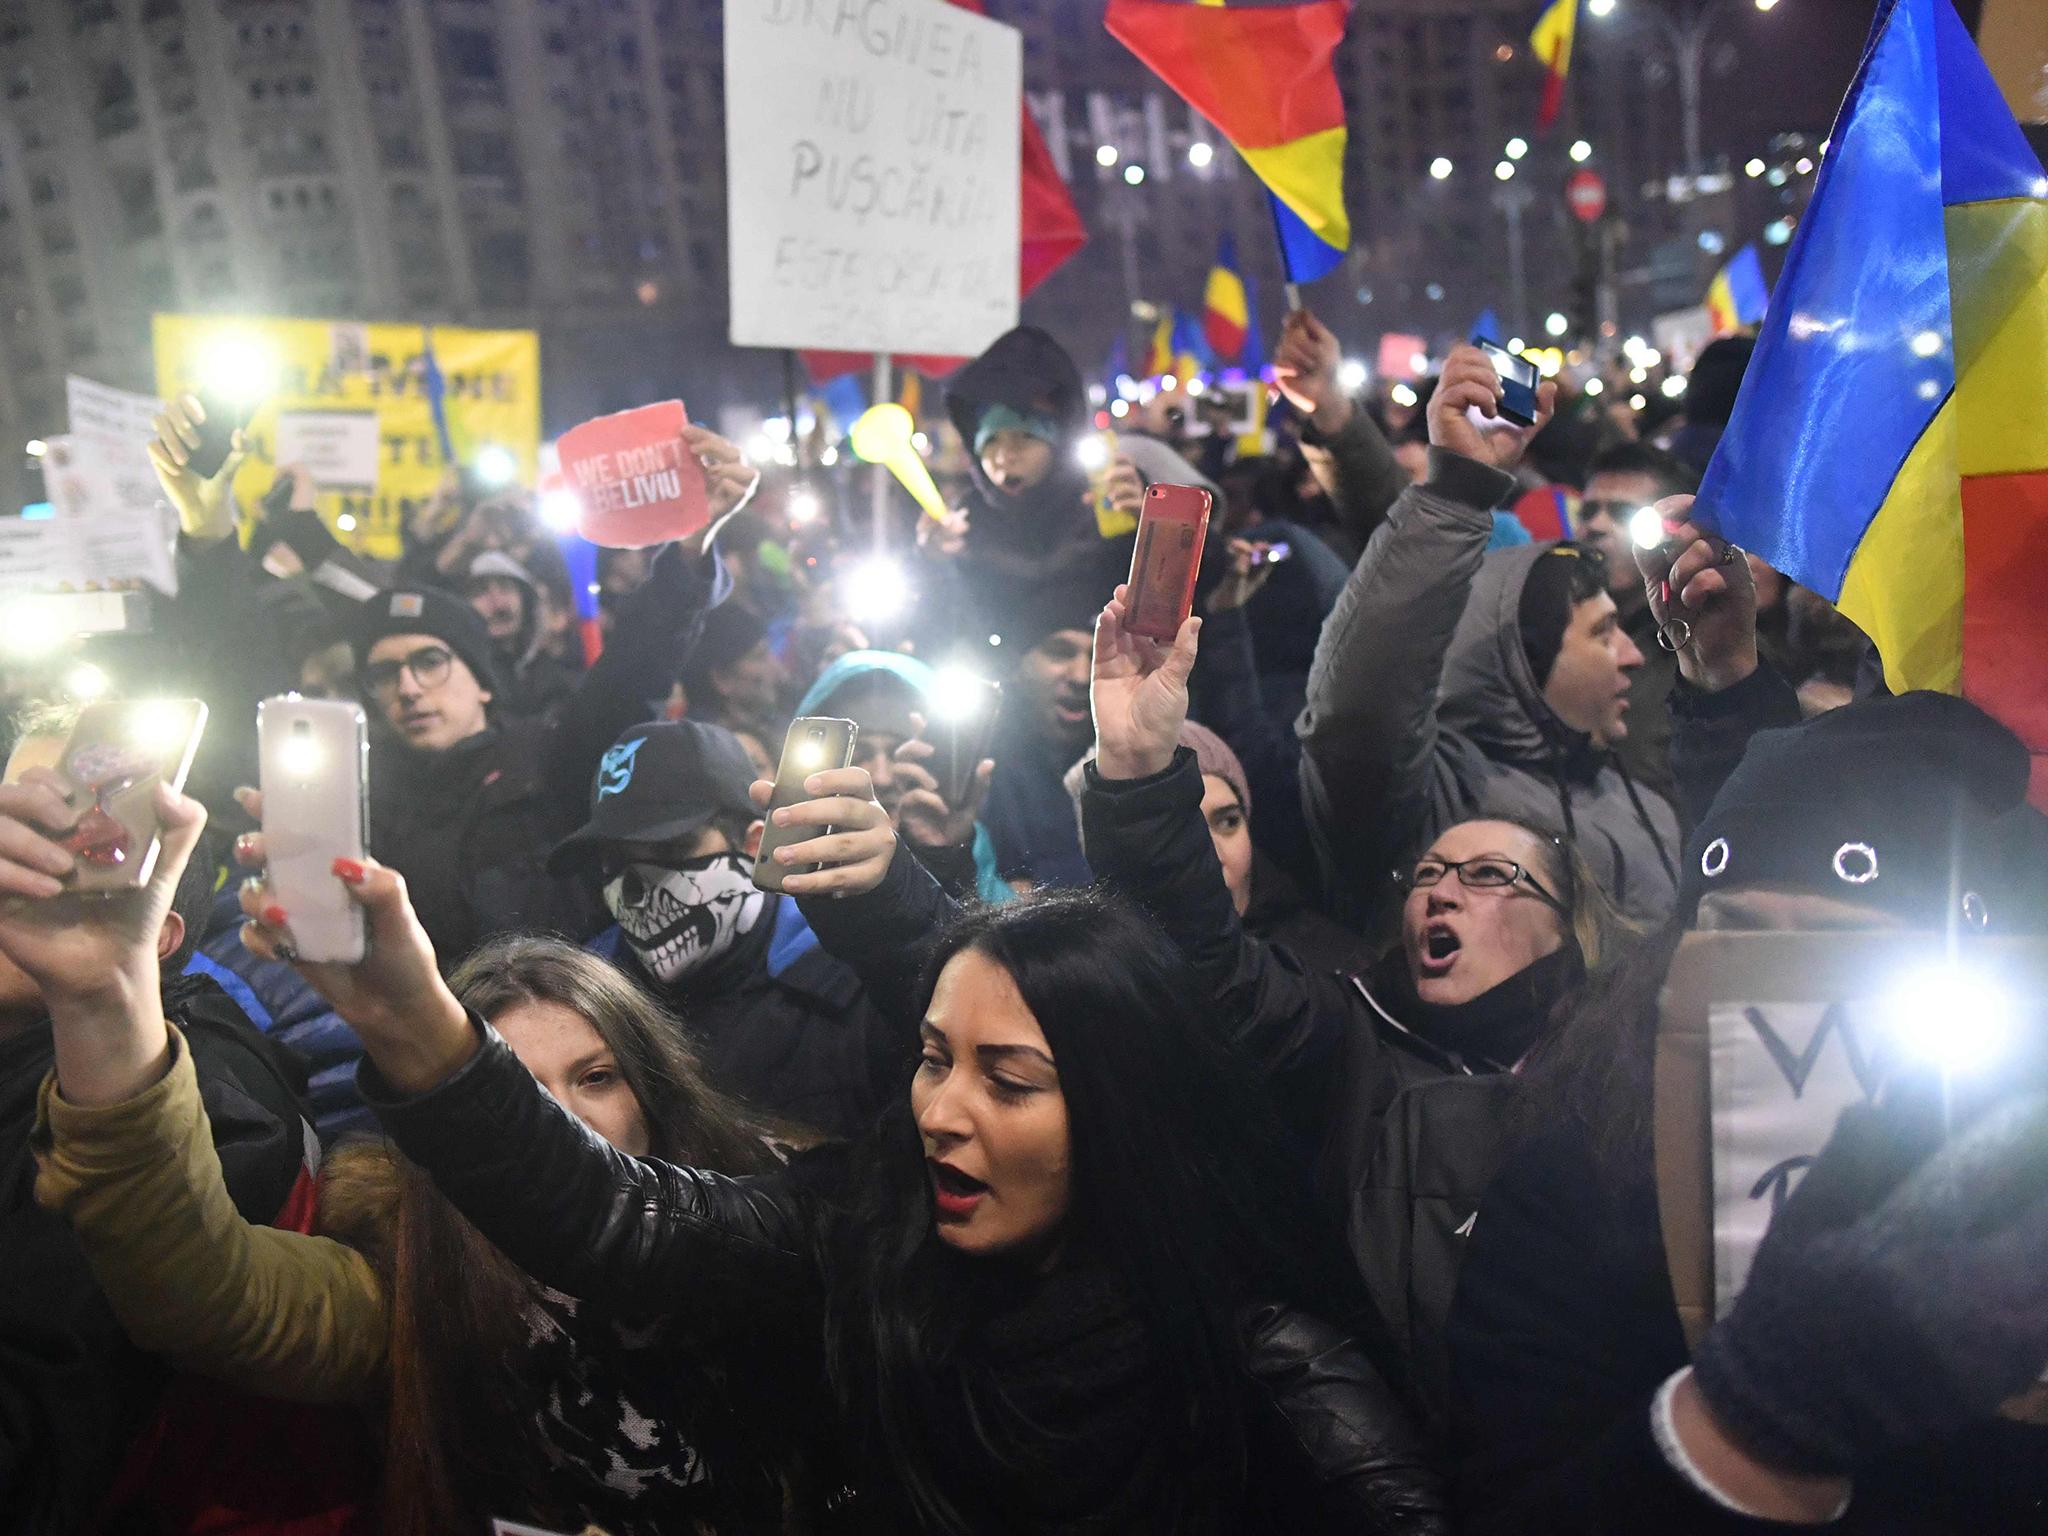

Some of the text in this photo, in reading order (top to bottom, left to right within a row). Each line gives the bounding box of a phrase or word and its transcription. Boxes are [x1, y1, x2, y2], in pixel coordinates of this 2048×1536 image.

[815, 76, 875, 134] NU
[572, 438, 683, 487] WE DON'T
